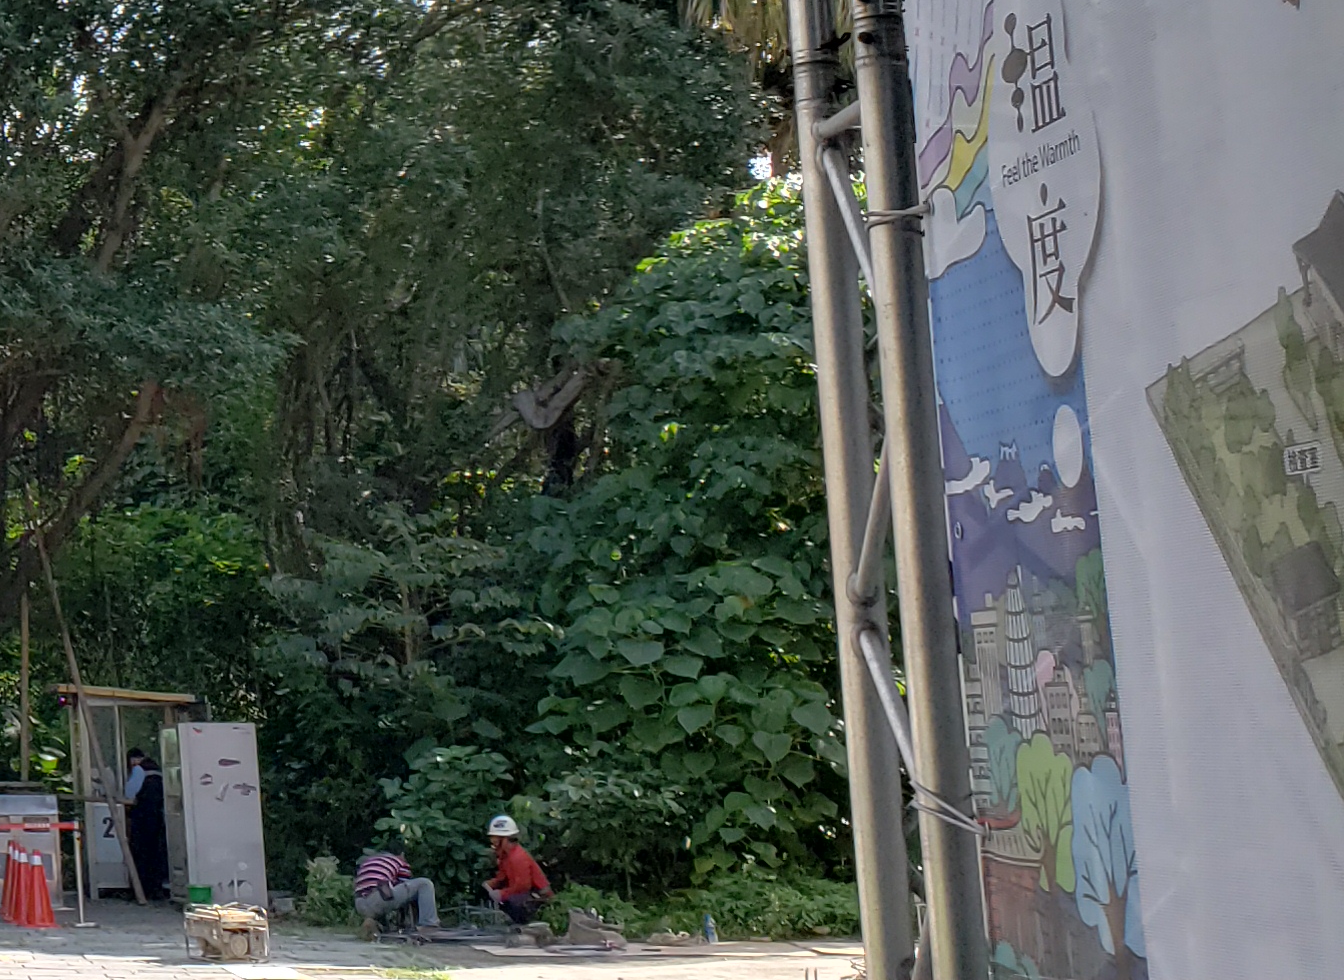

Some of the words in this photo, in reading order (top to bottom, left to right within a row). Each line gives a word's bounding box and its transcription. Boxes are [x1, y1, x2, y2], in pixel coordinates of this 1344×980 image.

[1001, 157, 1021, 188] Feel
[1021, 152, 1039, 178] the
[1038, 129, 1081, 168] Warmth
[1026, 182, 1076, 325] 度
[102, 816, 116, 839] 2
